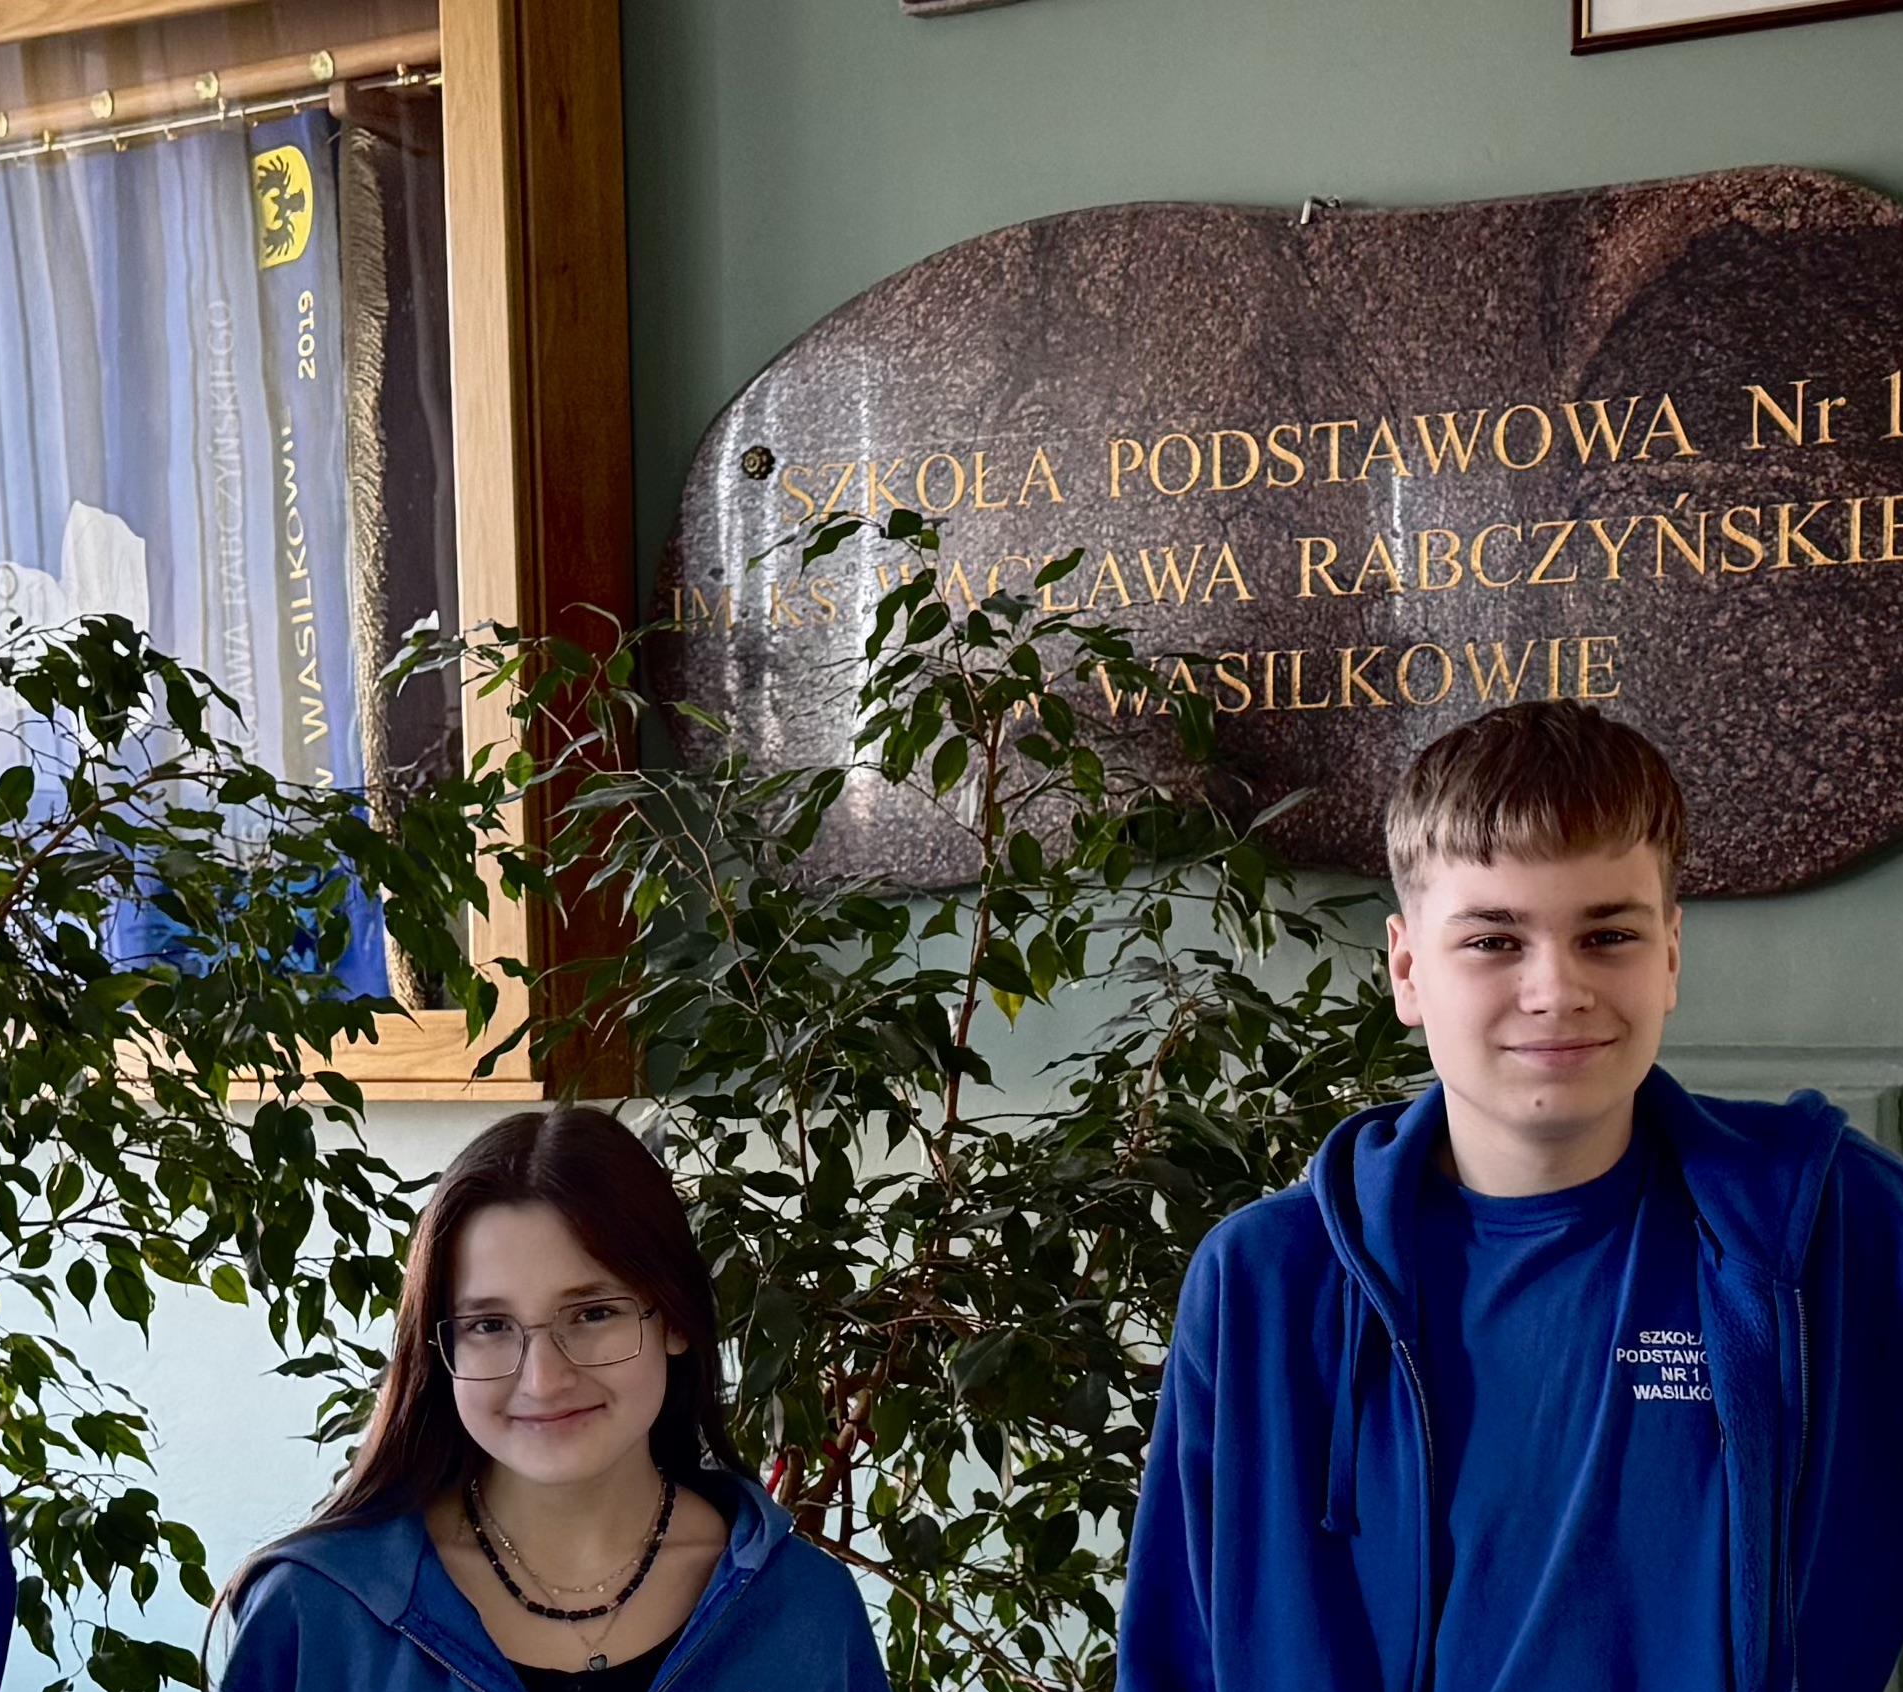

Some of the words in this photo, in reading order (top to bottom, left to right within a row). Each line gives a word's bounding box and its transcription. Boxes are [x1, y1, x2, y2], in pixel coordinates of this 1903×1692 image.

[298, 290, 316, 379] 2019
[779, 445, 1065, 523] SZKOŁA
[1108, 392, 1699, 498] PODSTAWOWA
[1742, 379, 1848, 451] Nr
[1661, 1366, 1687, 1382] NR
[1692, 1368, 1699, 1382] 1
